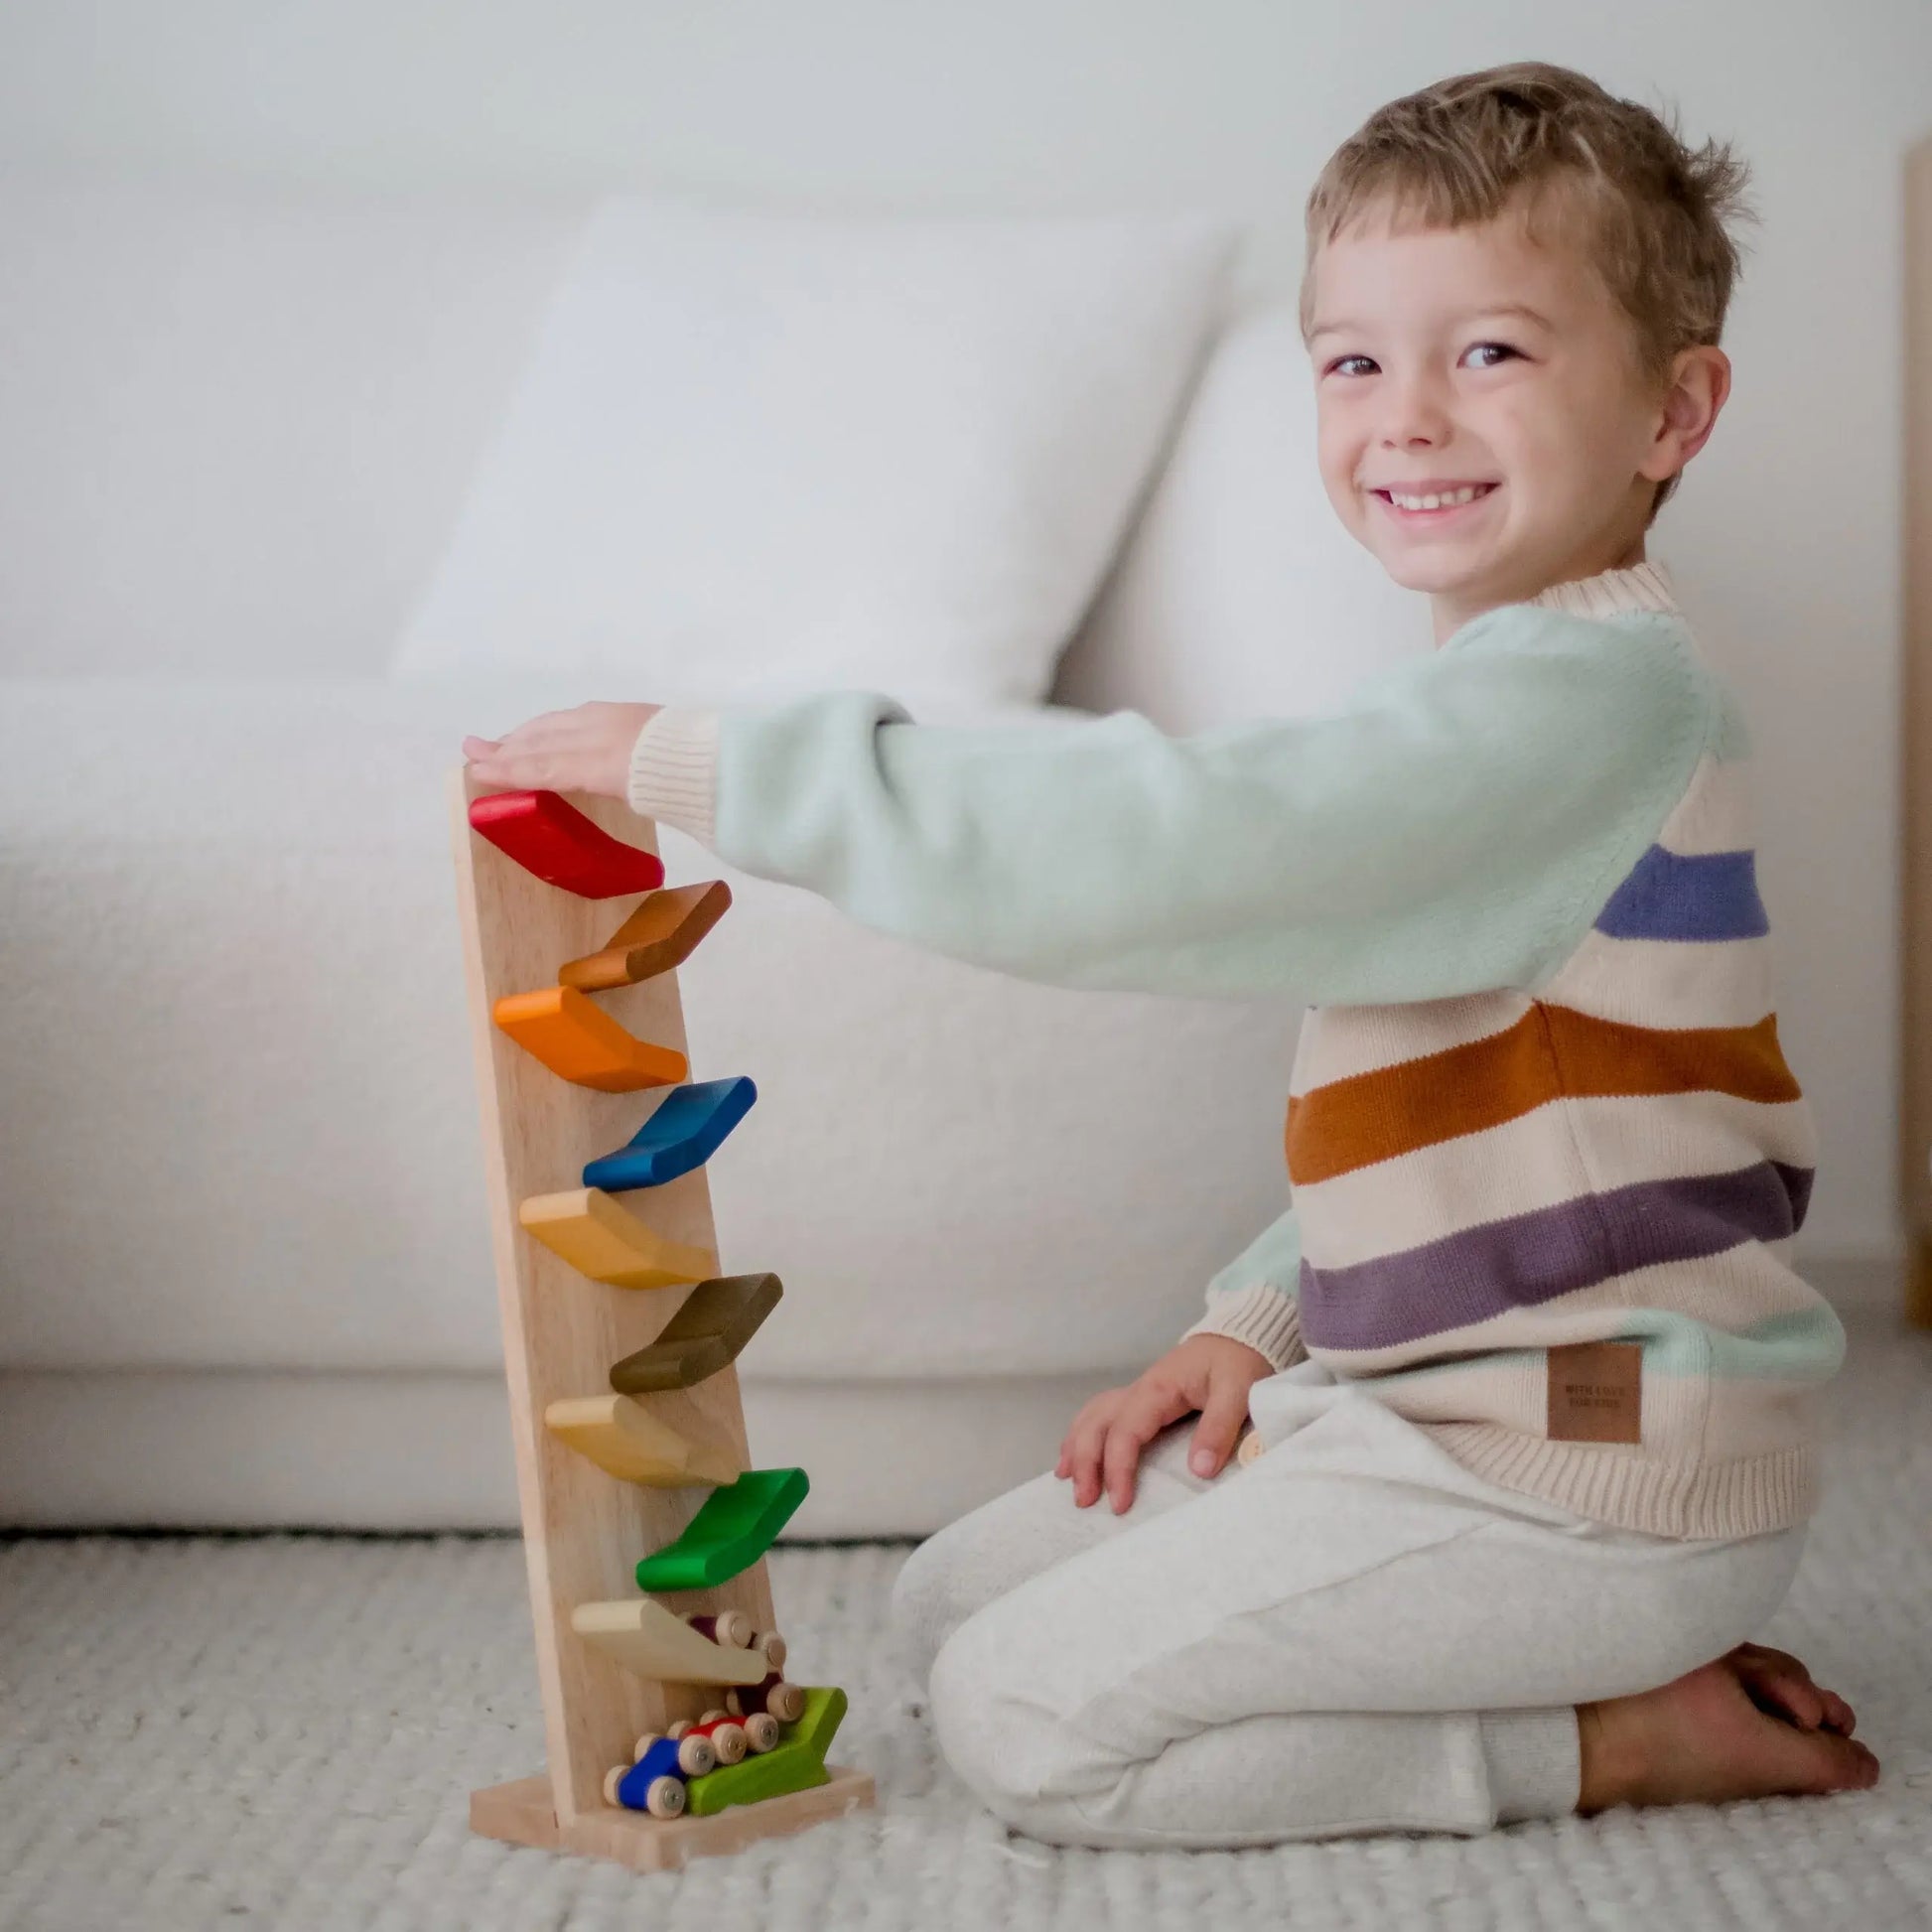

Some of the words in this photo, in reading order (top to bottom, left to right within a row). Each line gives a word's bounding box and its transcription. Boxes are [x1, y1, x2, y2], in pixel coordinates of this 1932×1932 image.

[1565, 1385, 1592, 1396] WITH
[1596, 1386, 1625, 1397] LOVE
[1570, 1397, 1590, 1408] FOR
